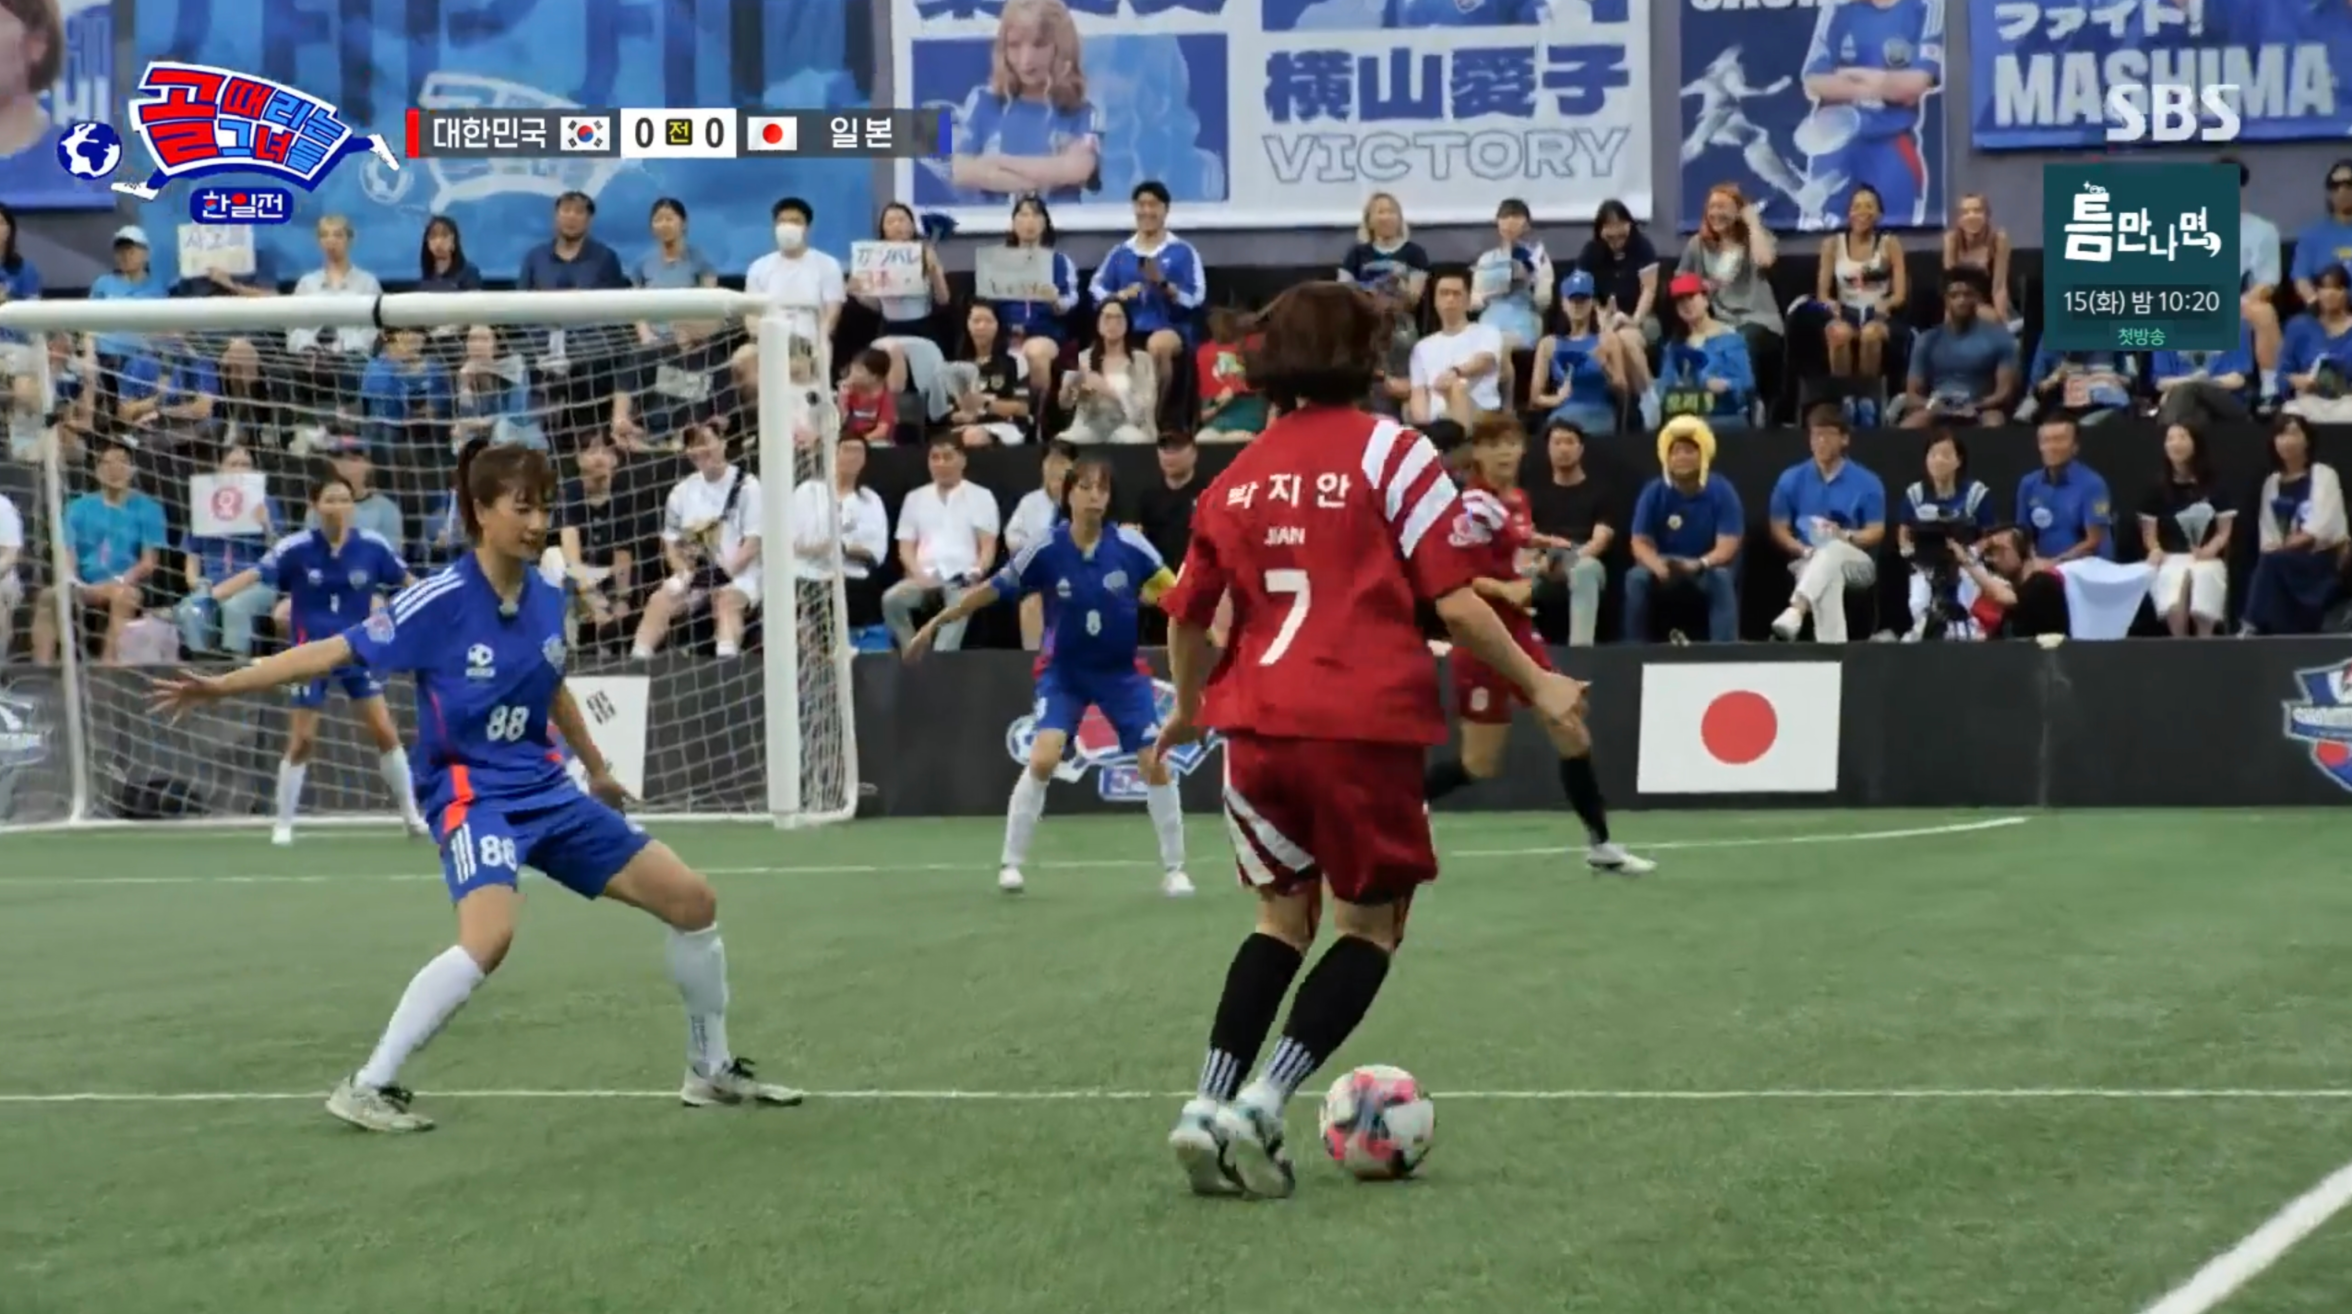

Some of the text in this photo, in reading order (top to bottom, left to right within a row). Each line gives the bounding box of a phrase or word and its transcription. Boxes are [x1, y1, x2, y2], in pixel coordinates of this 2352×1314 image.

[1264, 44, 1630, 123] 横山愛子
[1994, 43, 2335, 126] MASHIMA
[1261, 126, 1631, 184] VICTORY
[1264, 526, 1306, 546] JIAN
[1258, 567, 1312, 665] 7
[486, 705, 530, 742] 88
